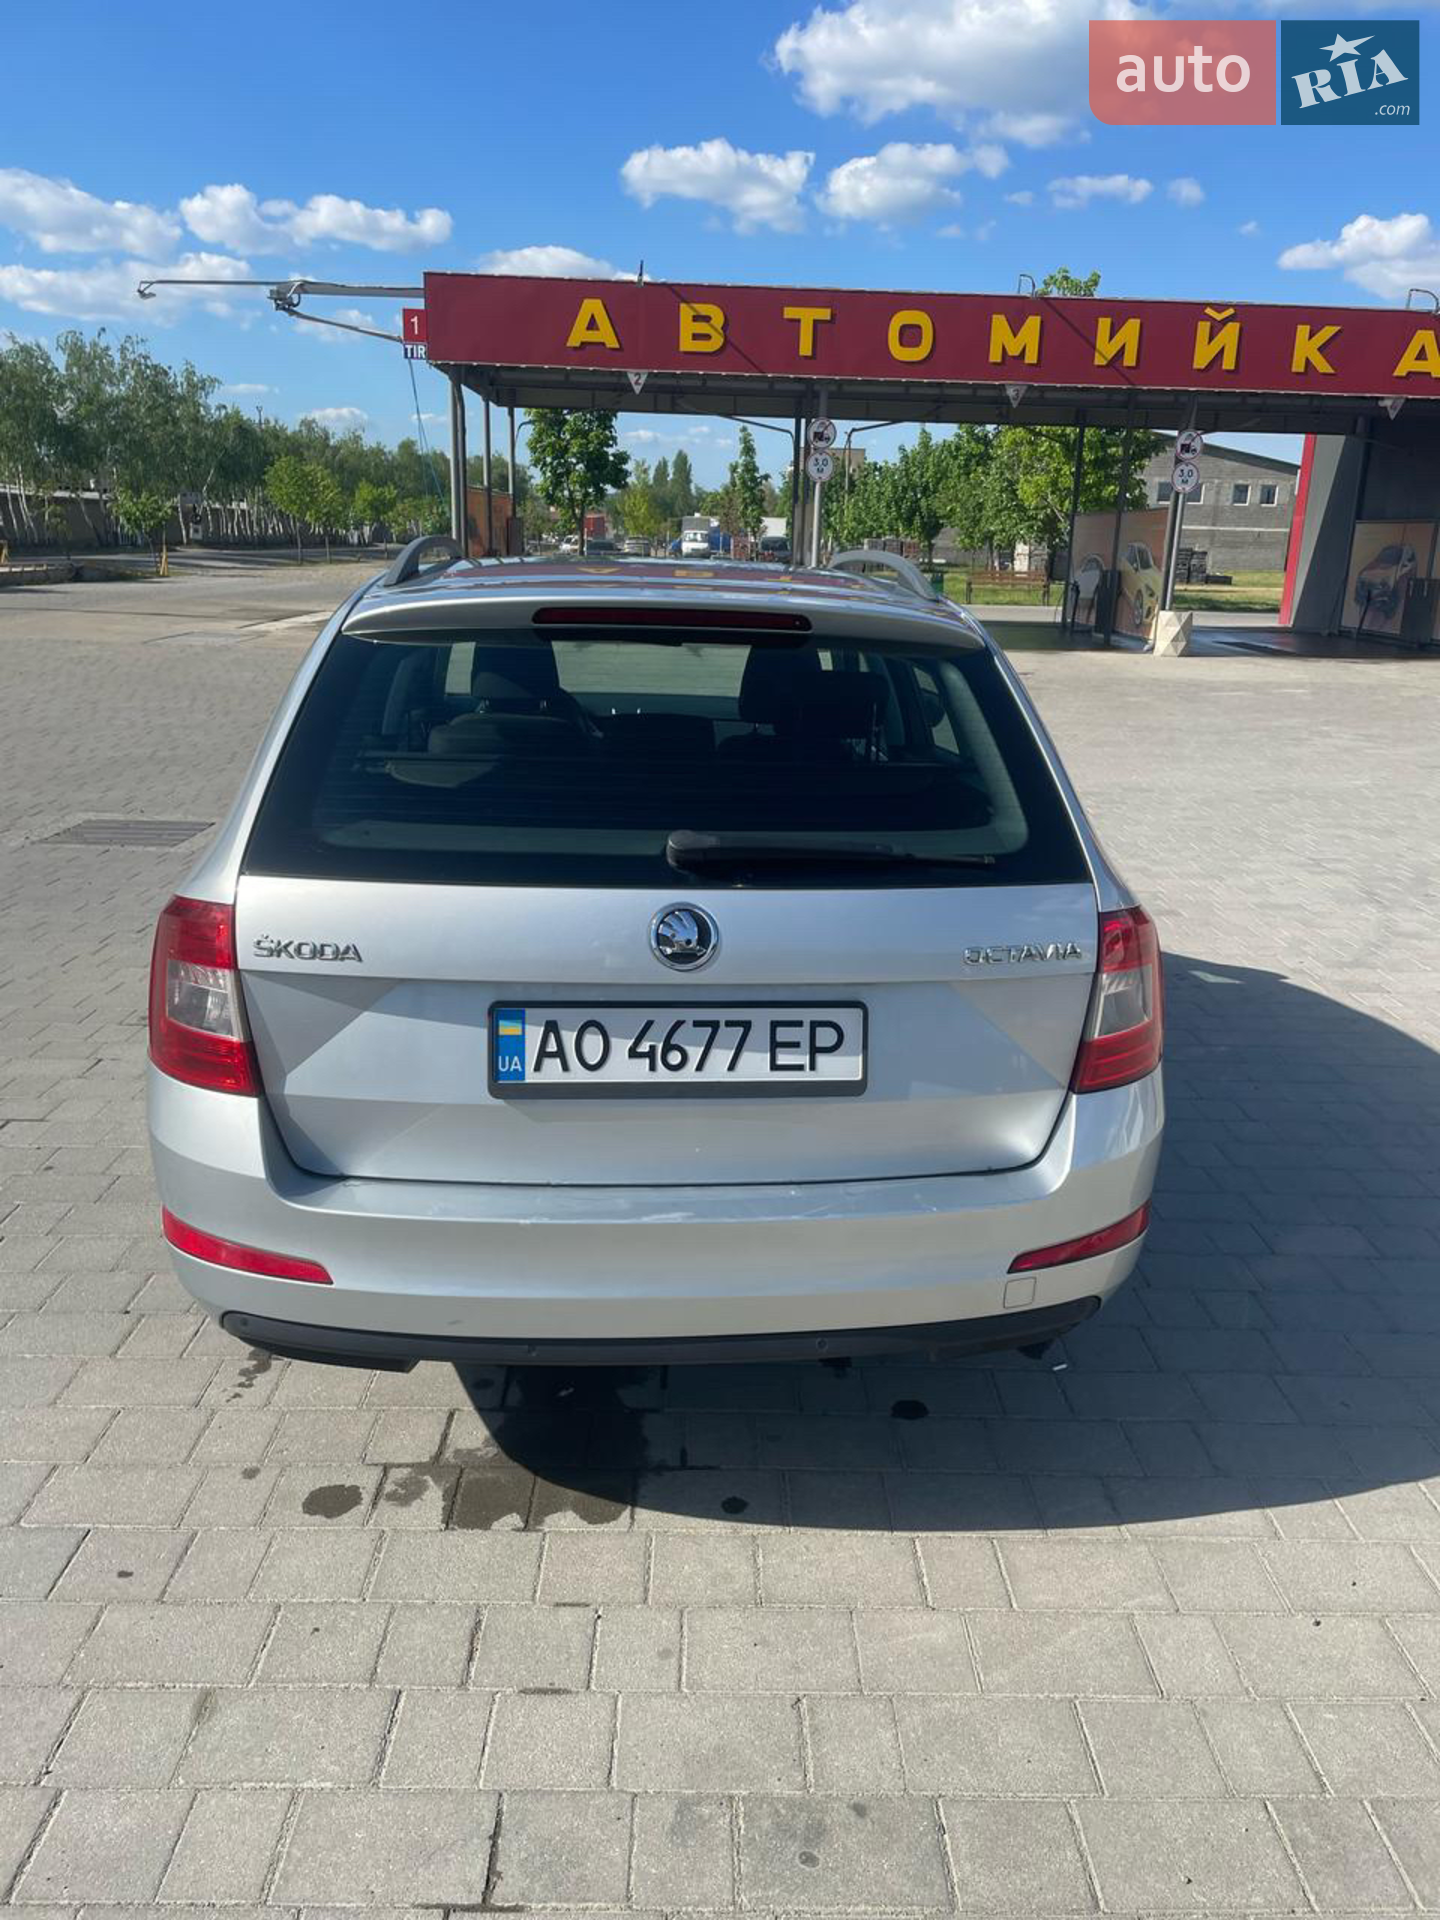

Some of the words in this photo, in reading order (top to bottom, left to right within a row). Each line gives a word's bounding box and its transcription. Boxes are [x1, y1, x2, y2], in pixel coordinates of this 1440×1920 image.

[410, 315, 418, 335] 1
[404, 345, 426, 358] TIR
[633, 372, 642, 385] 2
[963, 942, 1083, 966] OCTAVIA
[532, 1019, 611, 1073] AO
[627, 1019, 752, 1073] 4677
[768, 1019, 845, 1073] EP
[498, 1056, 523, 1072] UA
